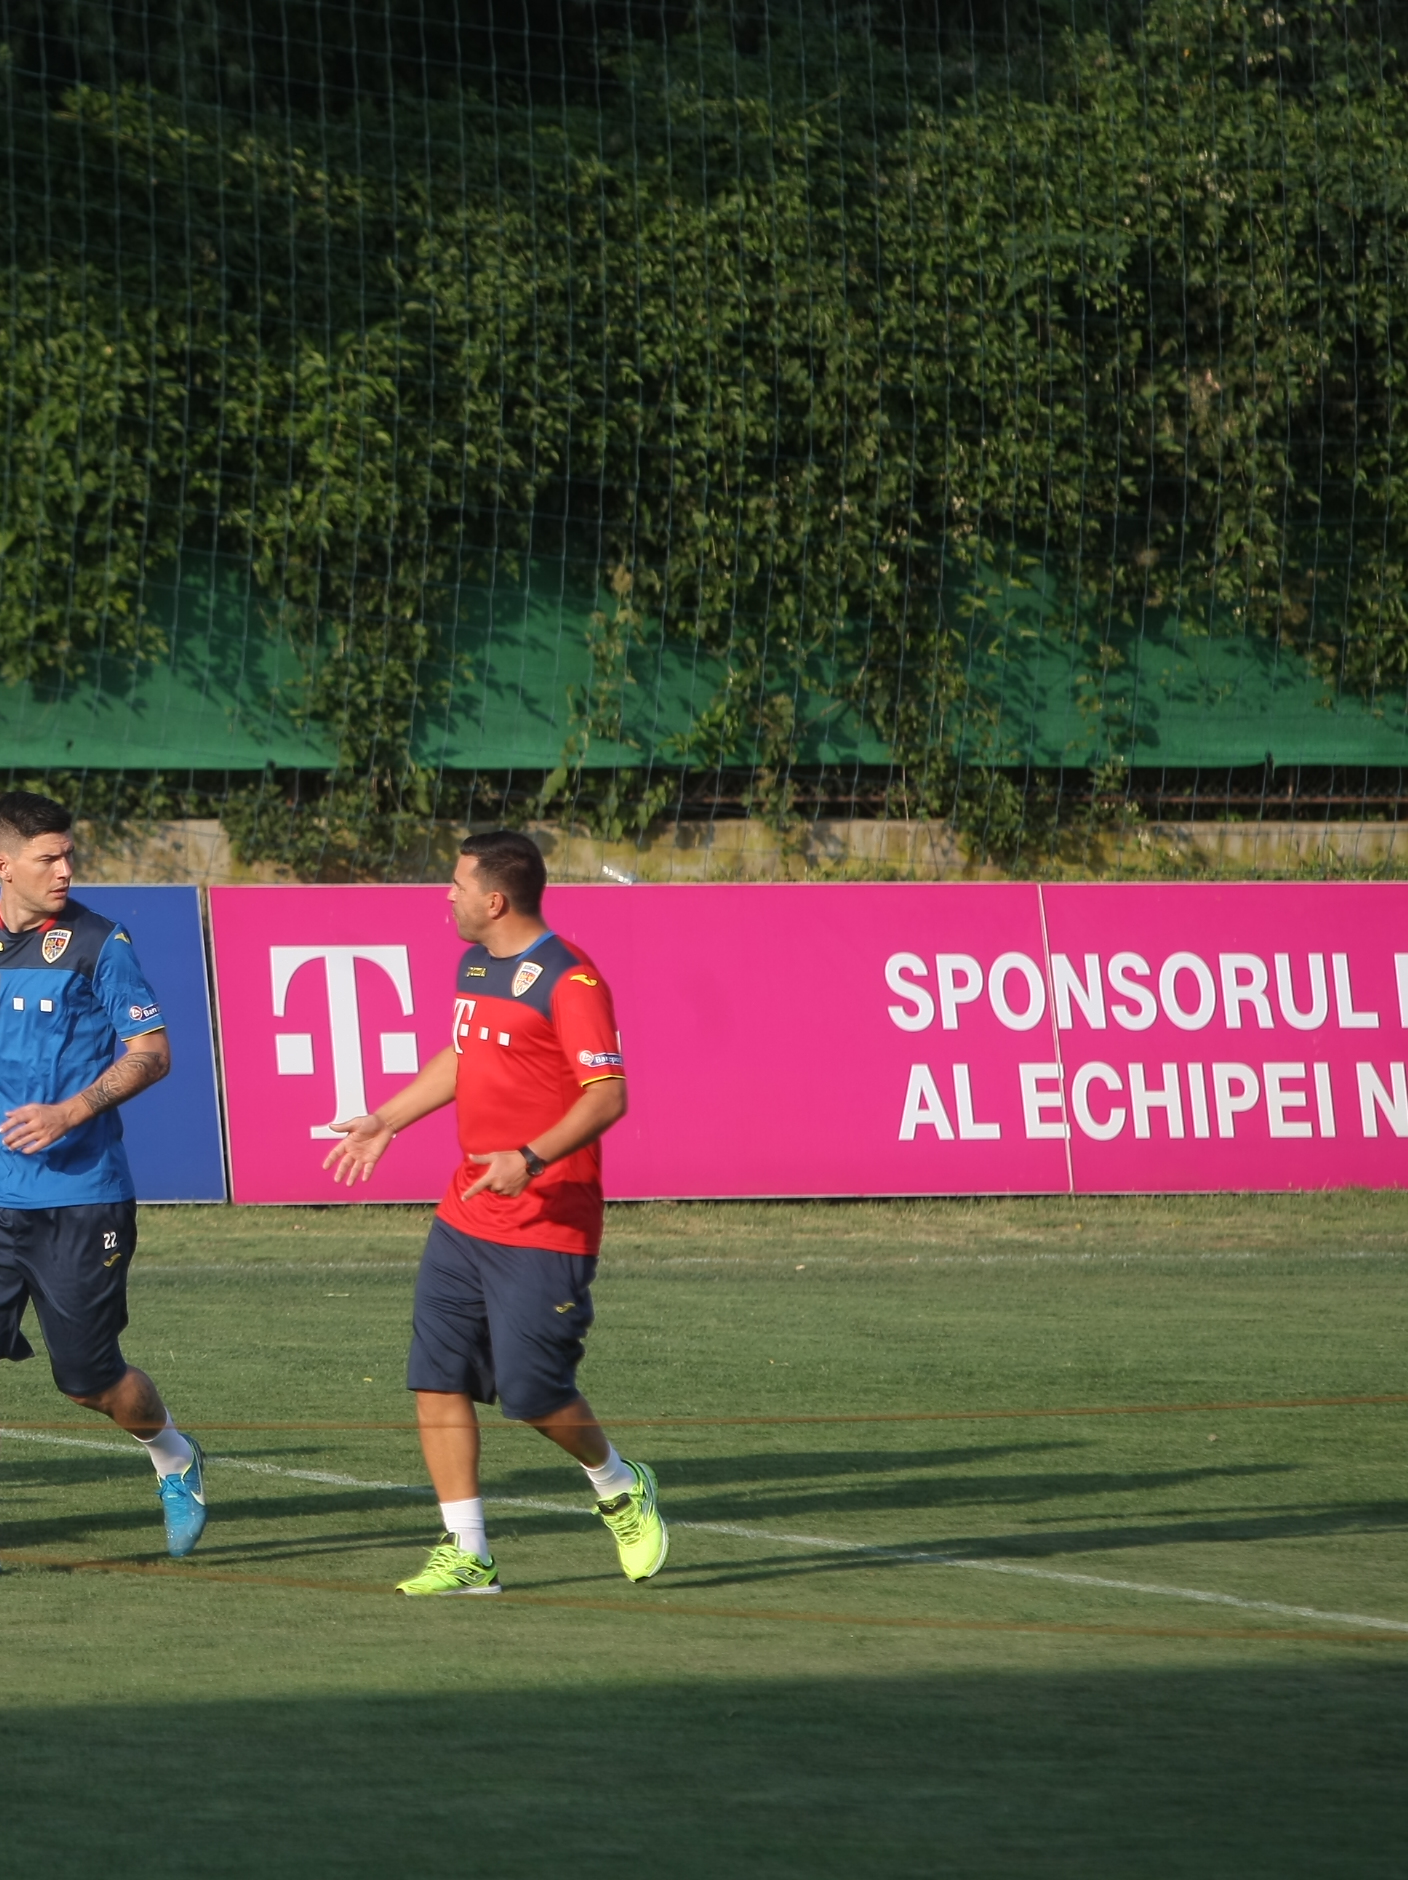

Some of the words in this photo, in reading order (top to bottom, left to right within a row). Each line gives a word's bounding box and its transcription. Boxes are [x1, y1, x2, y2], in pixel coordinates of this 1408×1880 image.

[884, 951, 1380, 1031] SPONSORUL
[270, 945, 419, 1139] T
[898, 1063, 1001, 1141] AL
[1018, 1061, 1336, 1141] ECHIPEI
[103, 1231, 117, 1250] 22
